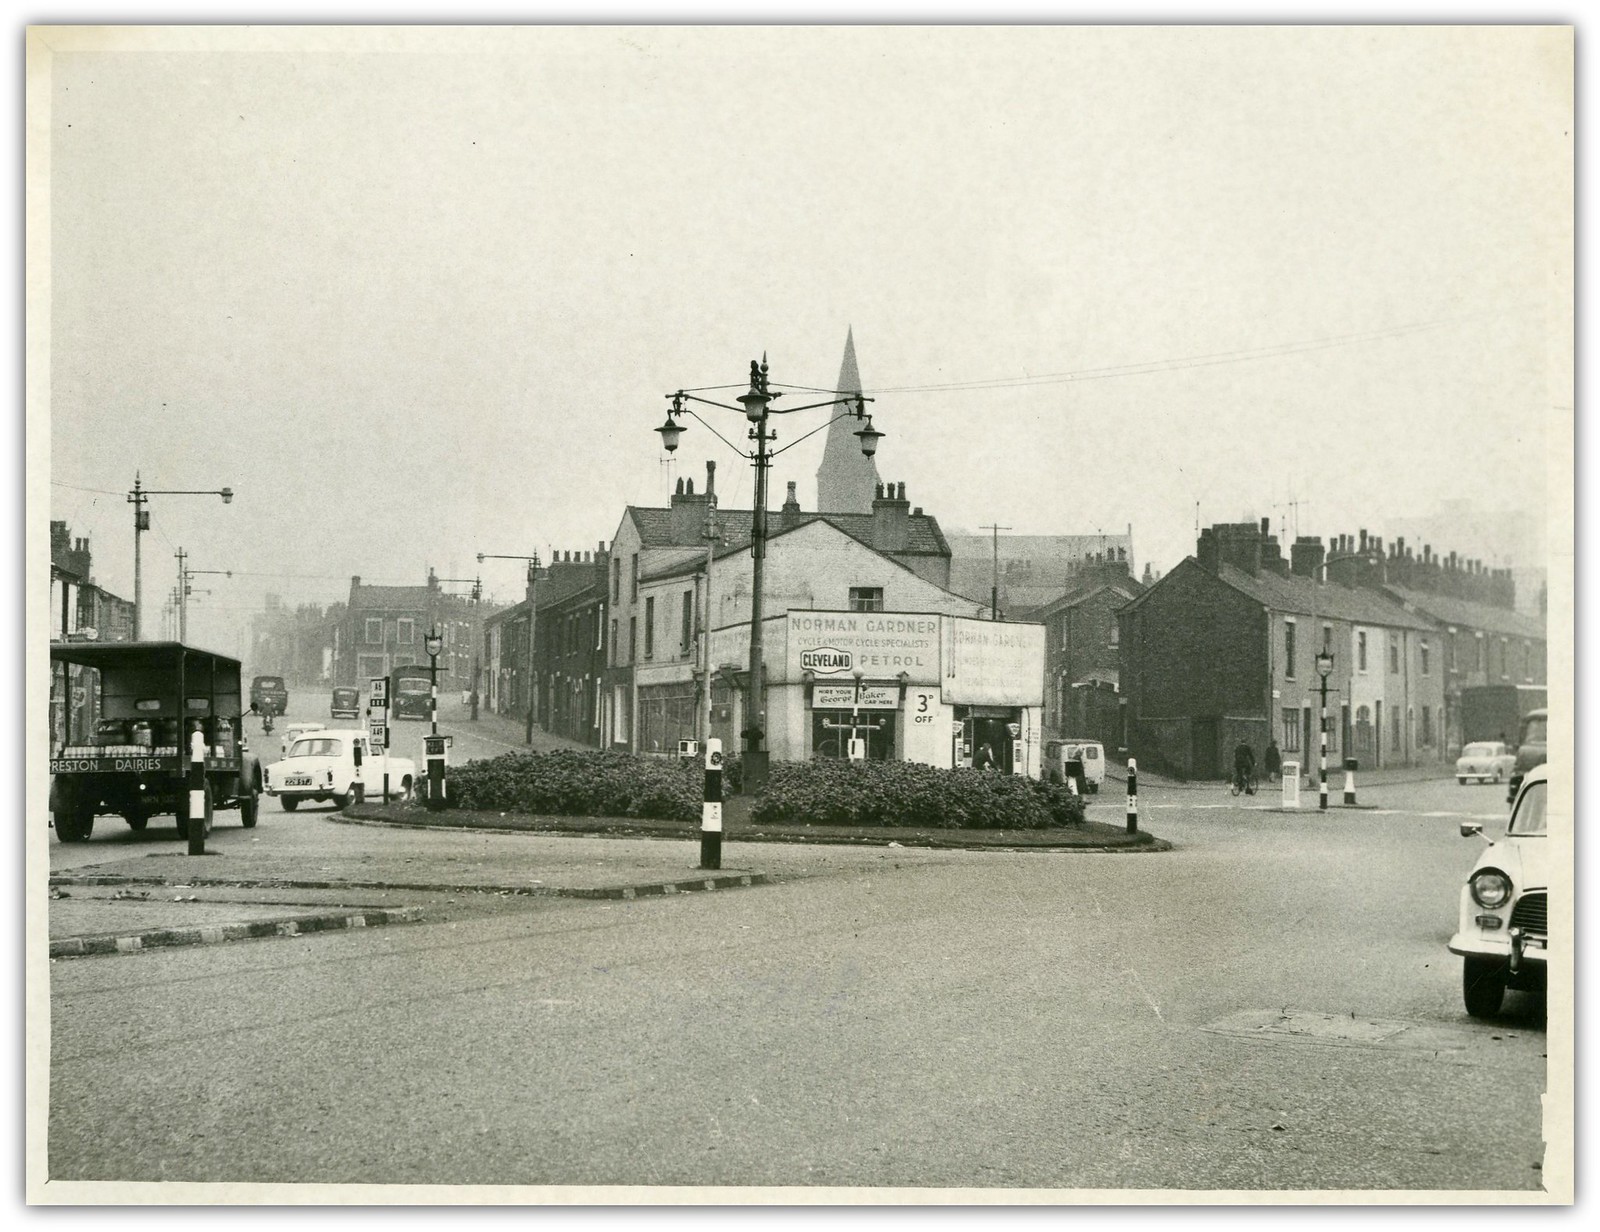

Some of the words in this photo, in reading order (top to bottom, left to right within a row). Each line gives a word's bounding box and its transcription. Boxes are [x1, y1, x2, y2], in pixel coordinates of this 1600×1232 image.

[792, 618, 857, 632] NORMAN
[866, 620, 936, 634] GARDNER
[797, 636, 821, 647] CYCLE
[828, 637, 853, 647] MOTOR
[855, 638, 879, 648] CYCLE
[881, 638, 929, 649] SPECIALISTS
[803, 653, 850, 668] CLEVELAND
[860, 655, 924, 668] PETROL
[820, 695, 852, 704] George
[859, 692, 886, 700] Baker
[914, 715, 933, 723] OFF
[50, 760, 98, 771] RESTON
[115, 758, 161, 771] DAIRIES
